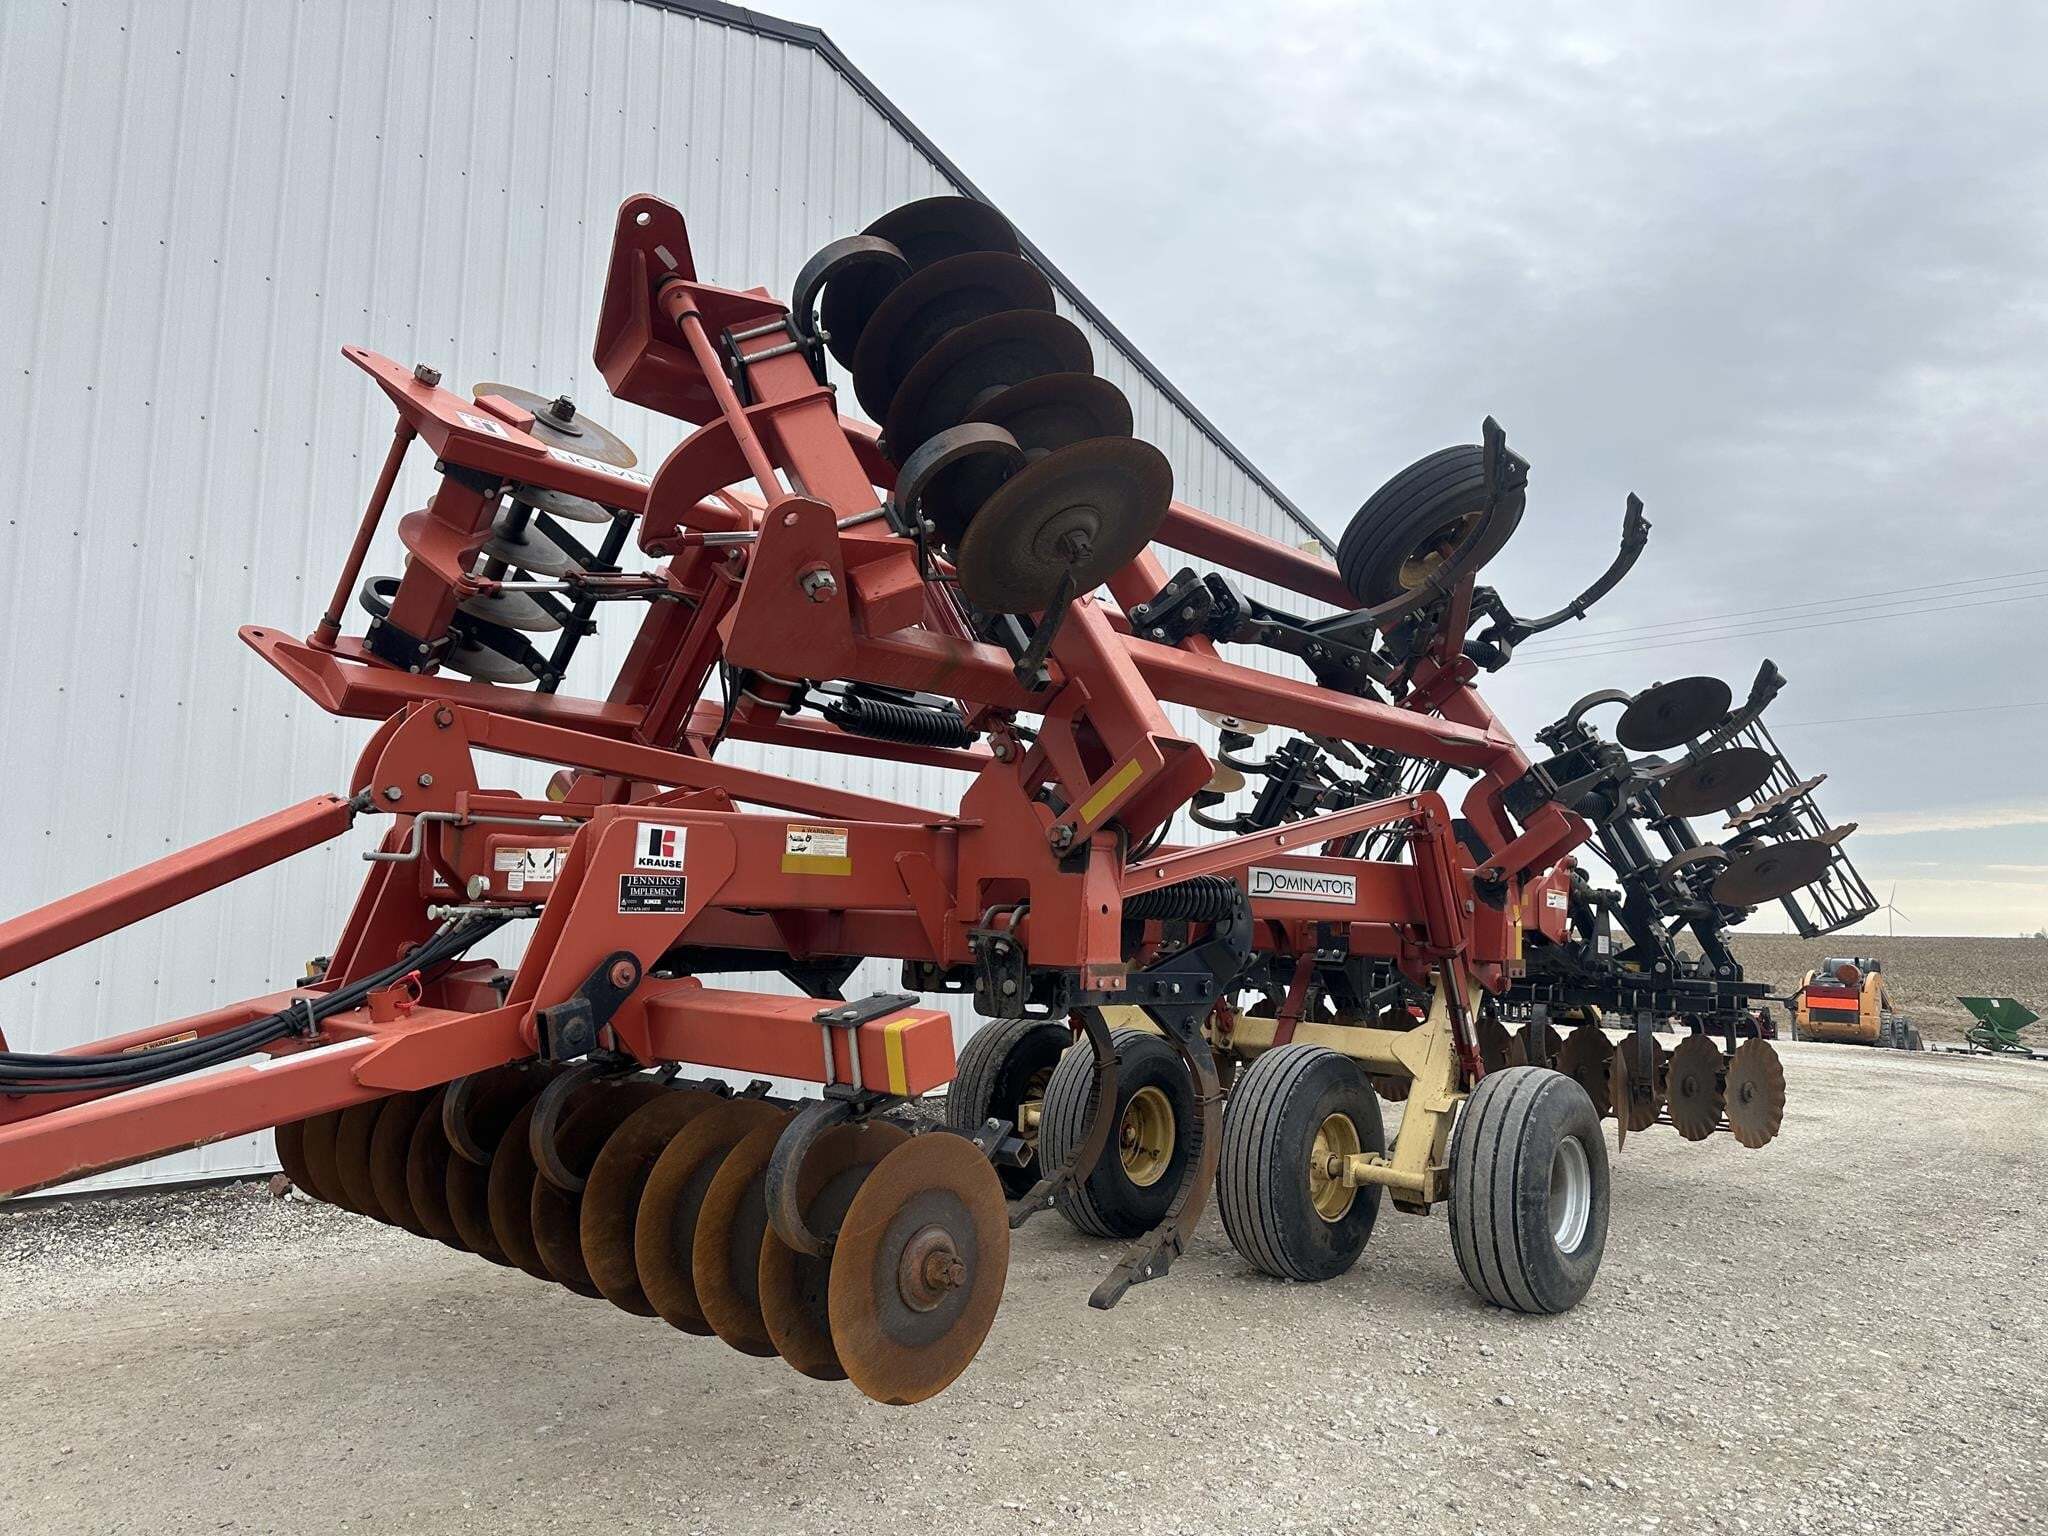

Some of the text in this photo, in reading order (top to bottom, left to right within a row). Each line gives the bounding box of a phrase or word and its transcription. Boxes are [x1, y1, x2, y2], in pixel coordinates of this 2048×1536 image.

[638, 857, 682, 869] KRAUSE
[627, 876, 681, 887] JENNINGS
[1252, 871, 1353, 895] DOMINATOR
[630, 887, 677, 896] IMPLEMENT
